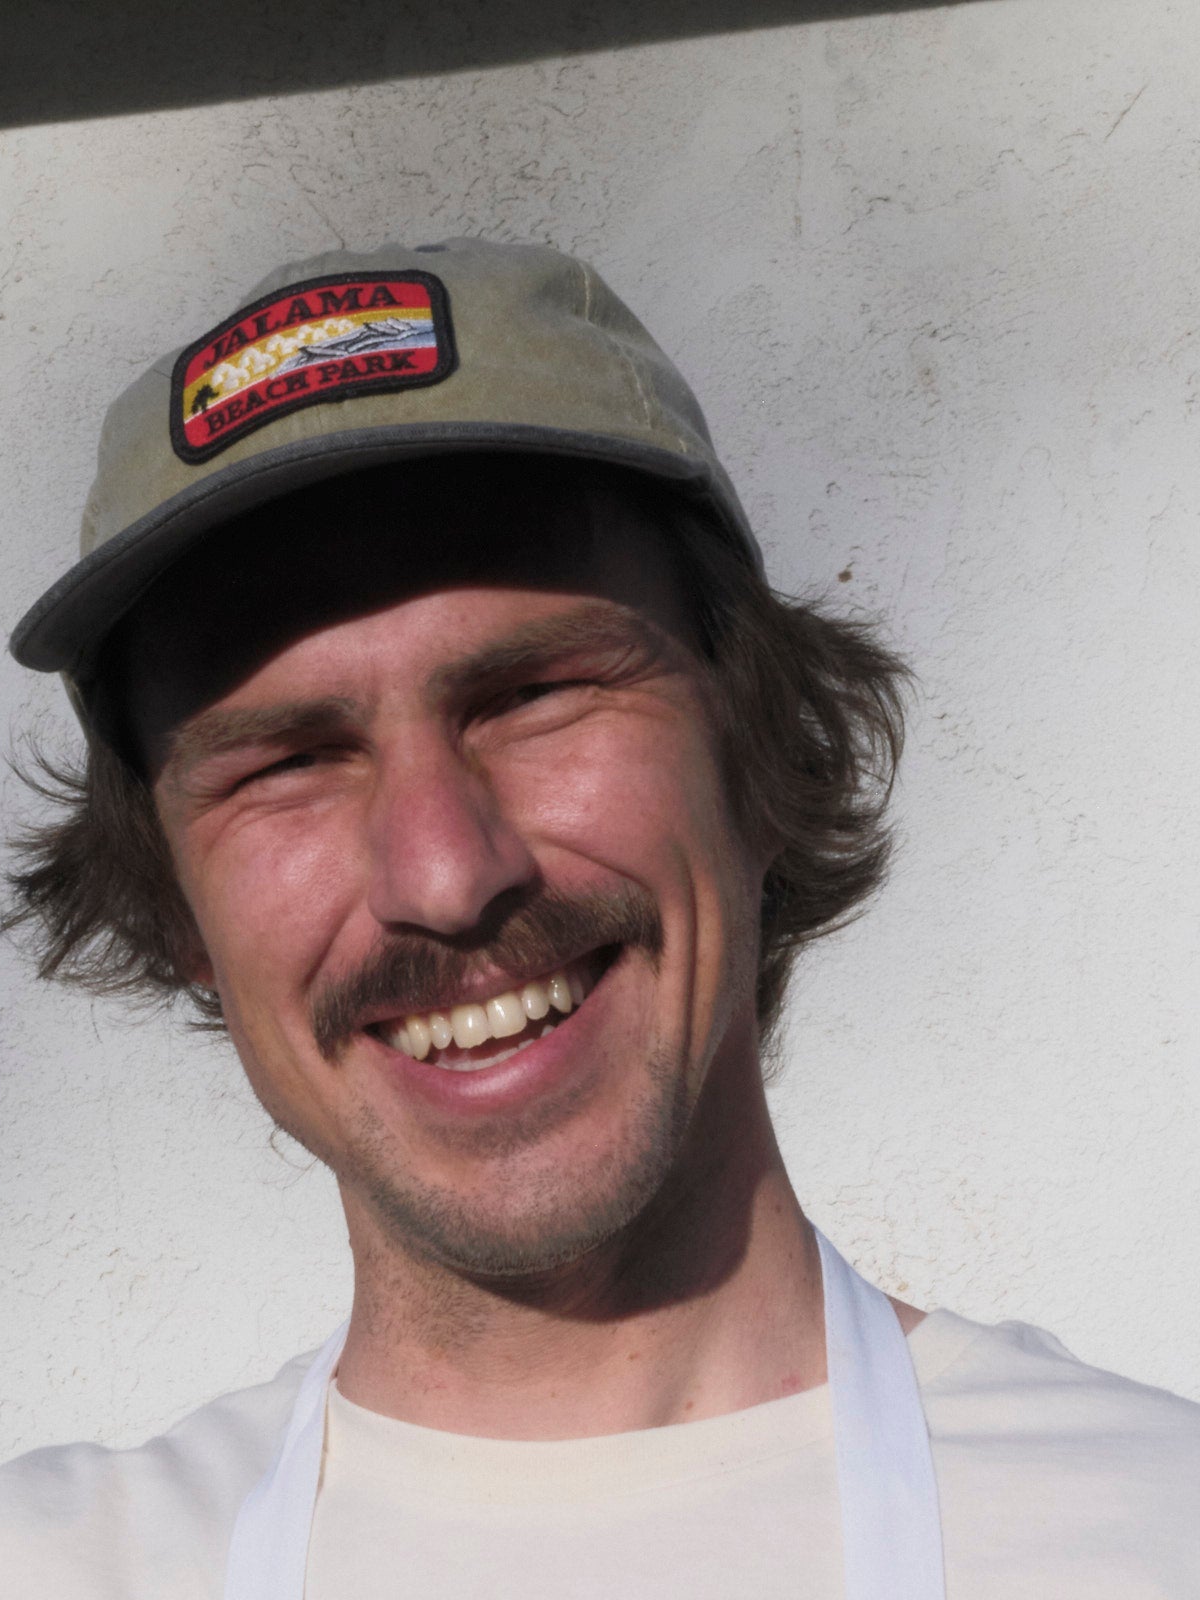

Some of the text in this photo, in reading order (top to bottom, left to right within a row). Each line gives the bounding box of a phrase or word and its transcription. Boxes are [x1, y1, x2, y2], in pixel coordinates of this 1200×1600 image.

[204, 285, 401, 368] JALAMA
[206, 351, 418, 436] BEACH PARK
